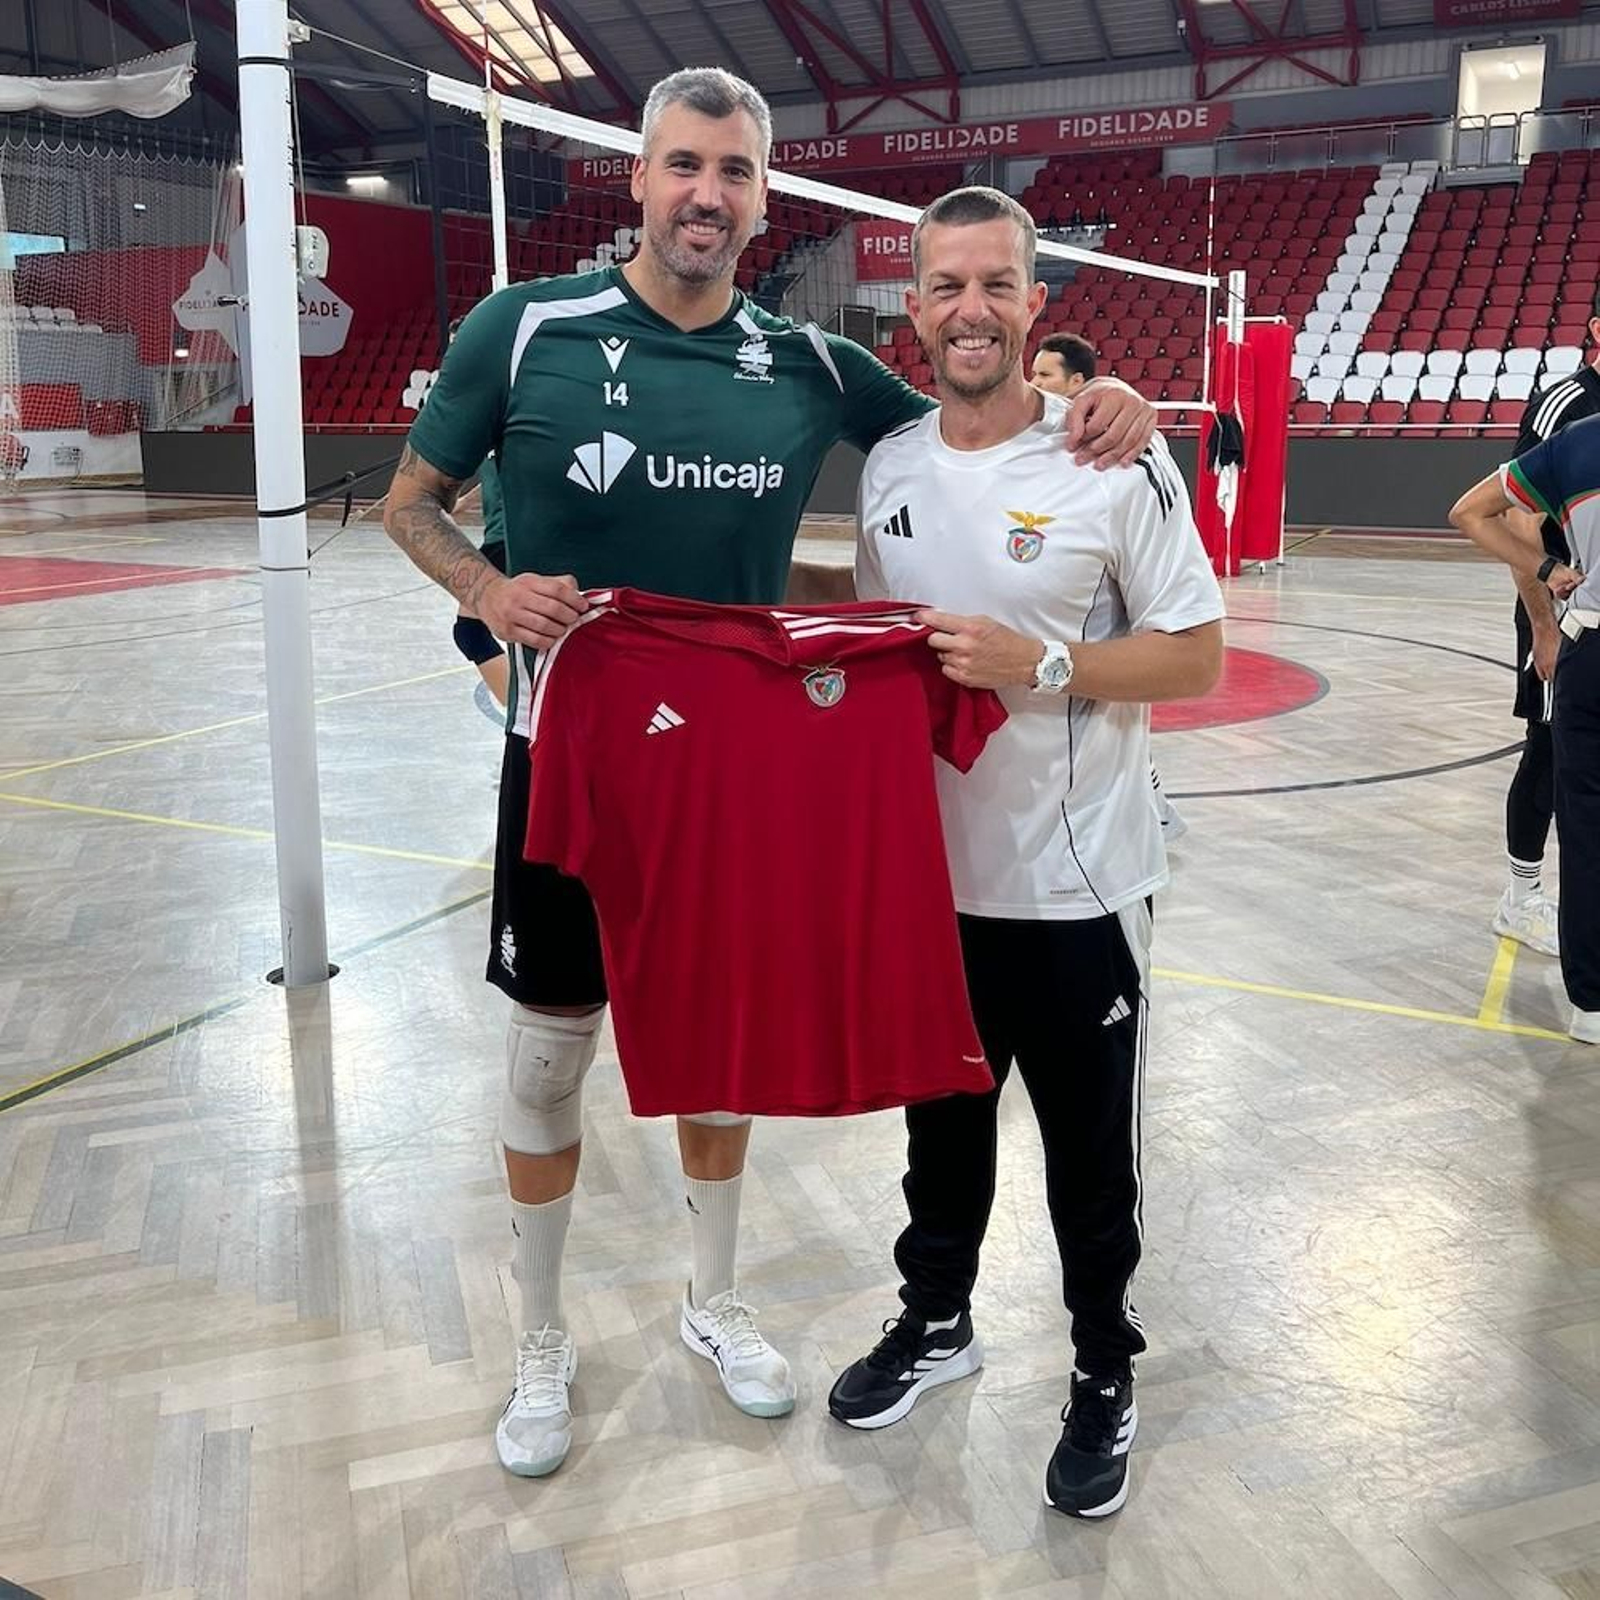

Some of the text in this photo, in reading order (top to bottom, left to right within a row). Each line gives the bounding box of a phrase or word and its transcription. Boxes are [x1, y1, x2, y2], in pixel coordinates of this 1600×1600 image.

[1058, 107, 1209, 139] FIDELIDADE
[771, 139, 848, 163] LIDADE
[883, 124, 1019, 154] FIDELIDADE
[583, 158, 631, 178] FIDEL
[603, 381, 629, 406] 14
[646, 454, 784, 498] Unicaja
